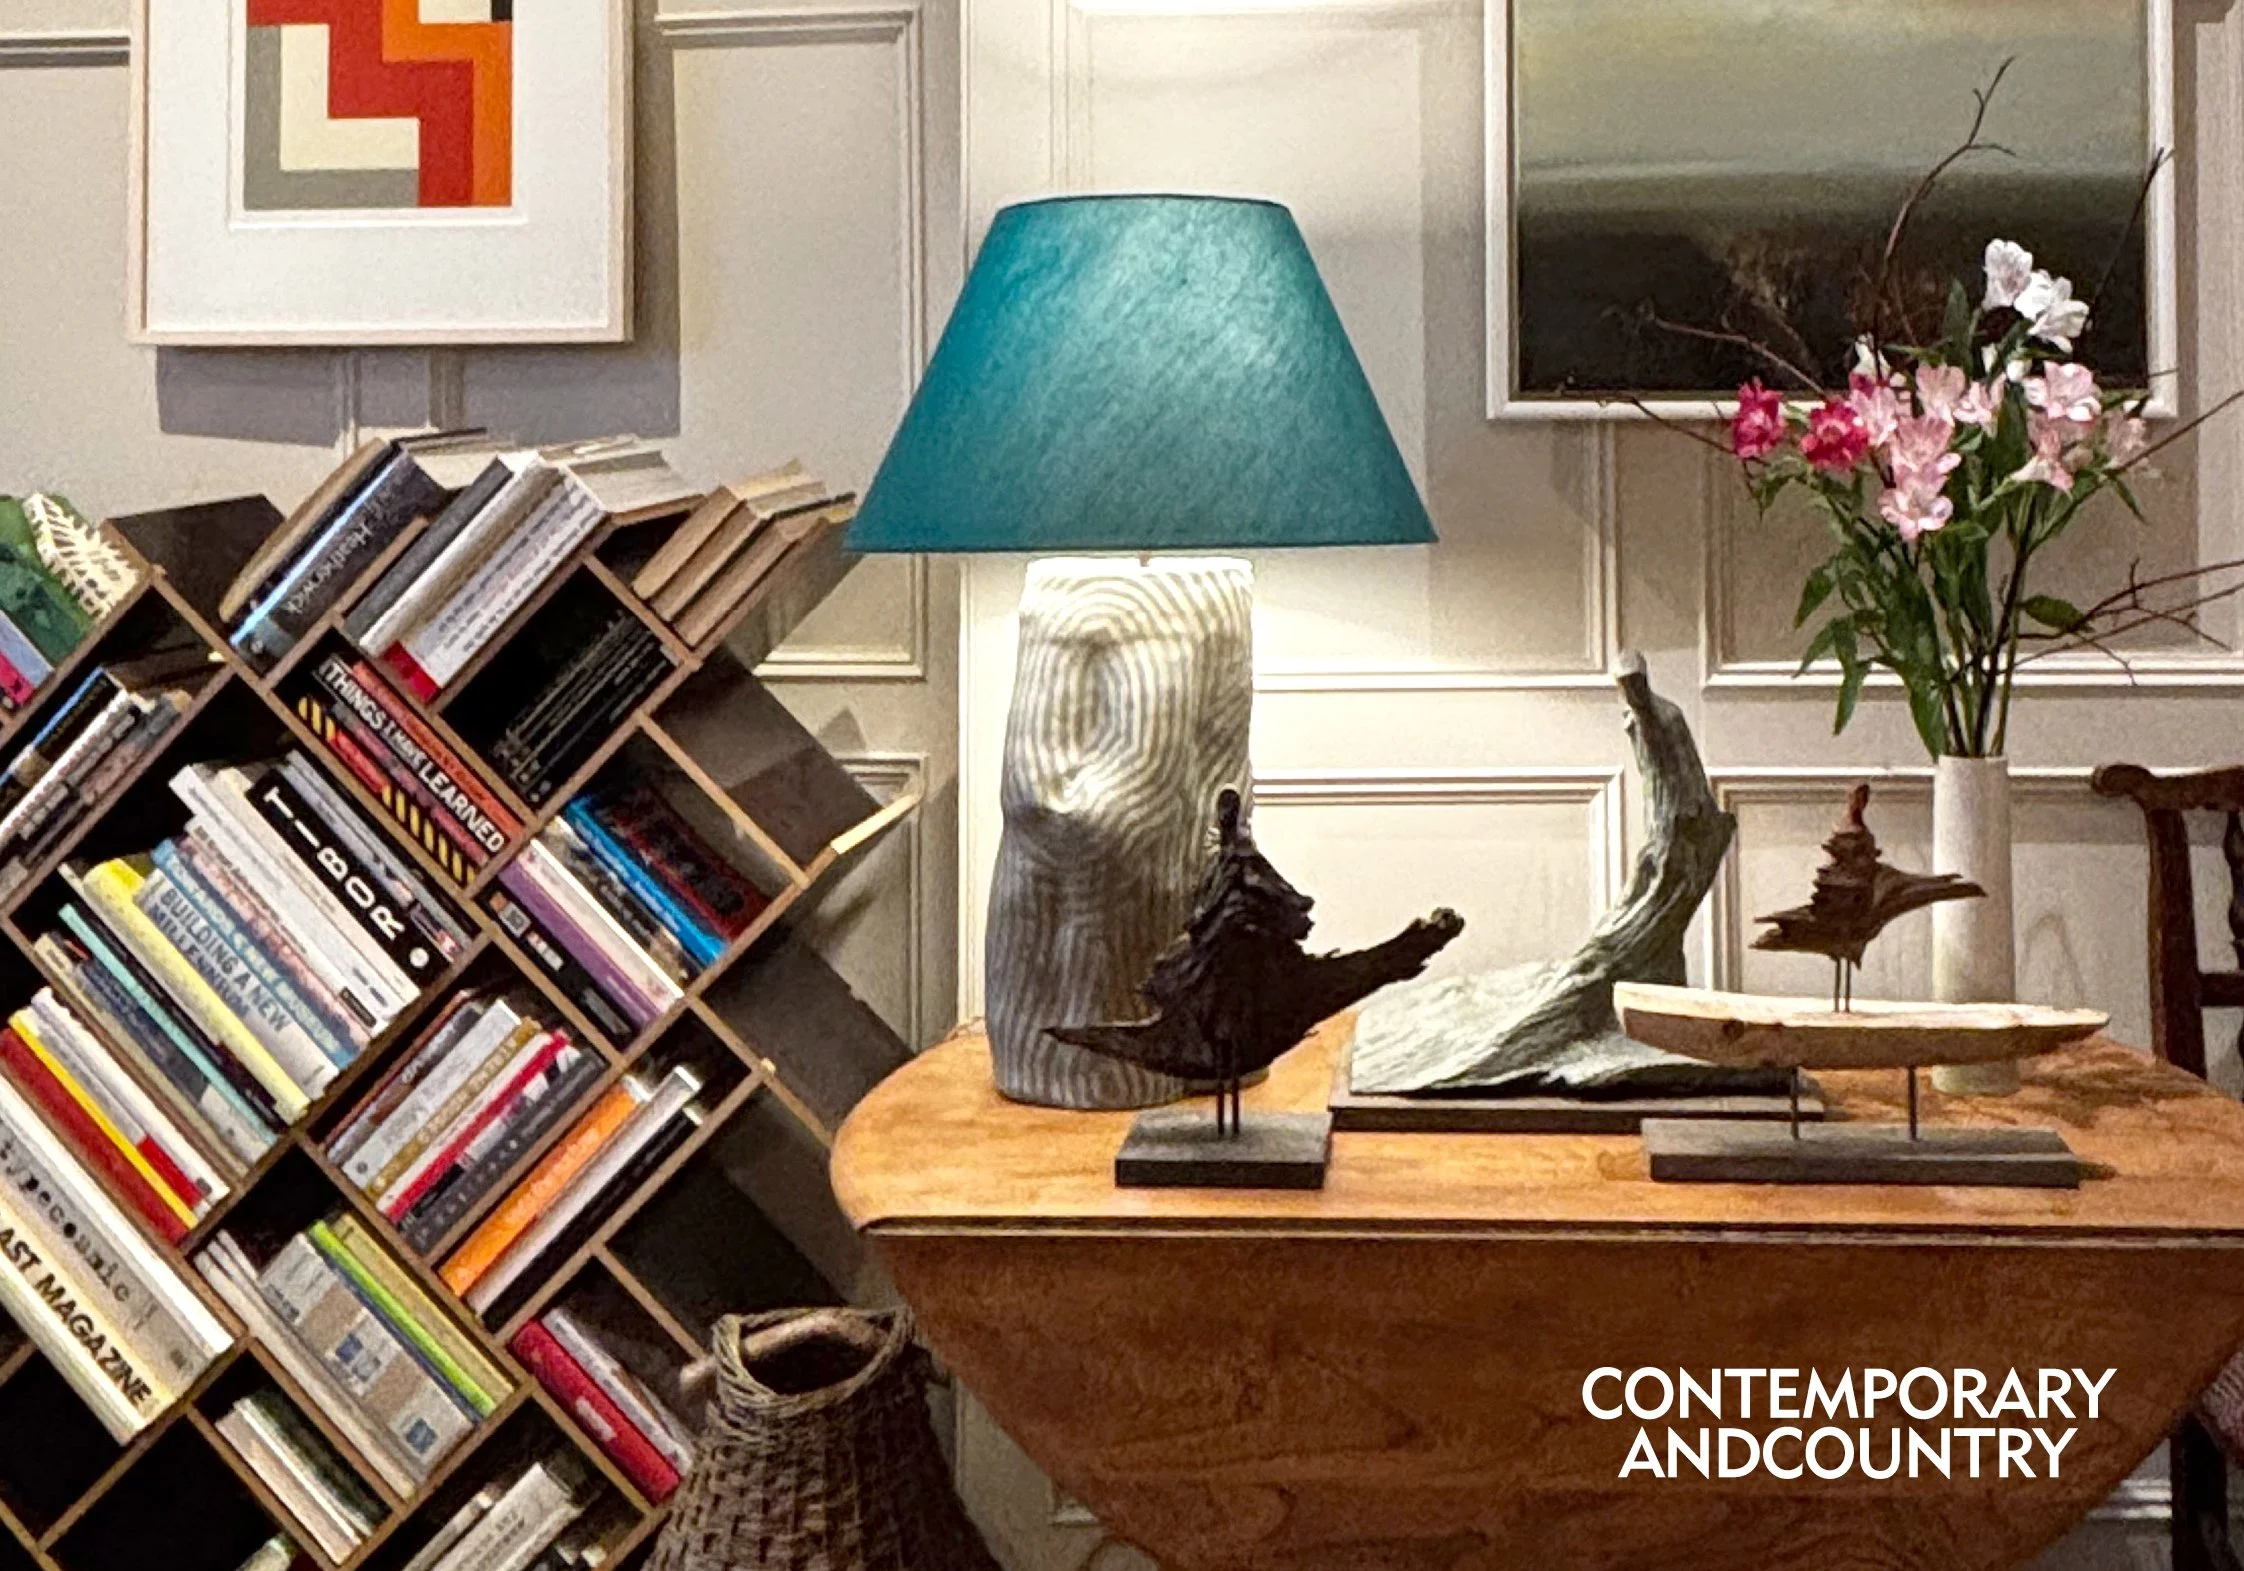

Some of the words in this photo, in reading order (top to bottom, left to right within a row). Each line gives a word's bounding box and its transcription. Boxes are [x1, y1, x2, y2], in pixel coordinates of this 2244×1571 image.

[285, 522, 372, 614] Heatherwick
[321, 663, 389, 731] THINGS
[417, 762, 506, 852] LEARNED
[263, 786, 406, 940] TIBOR
[159, 887, 241, 976] BUILDING
[233, 970, 254, 990] A
[245, 986, 290, 1032] NEW
[34, 1272, 152, 1407] MAGAZINE
